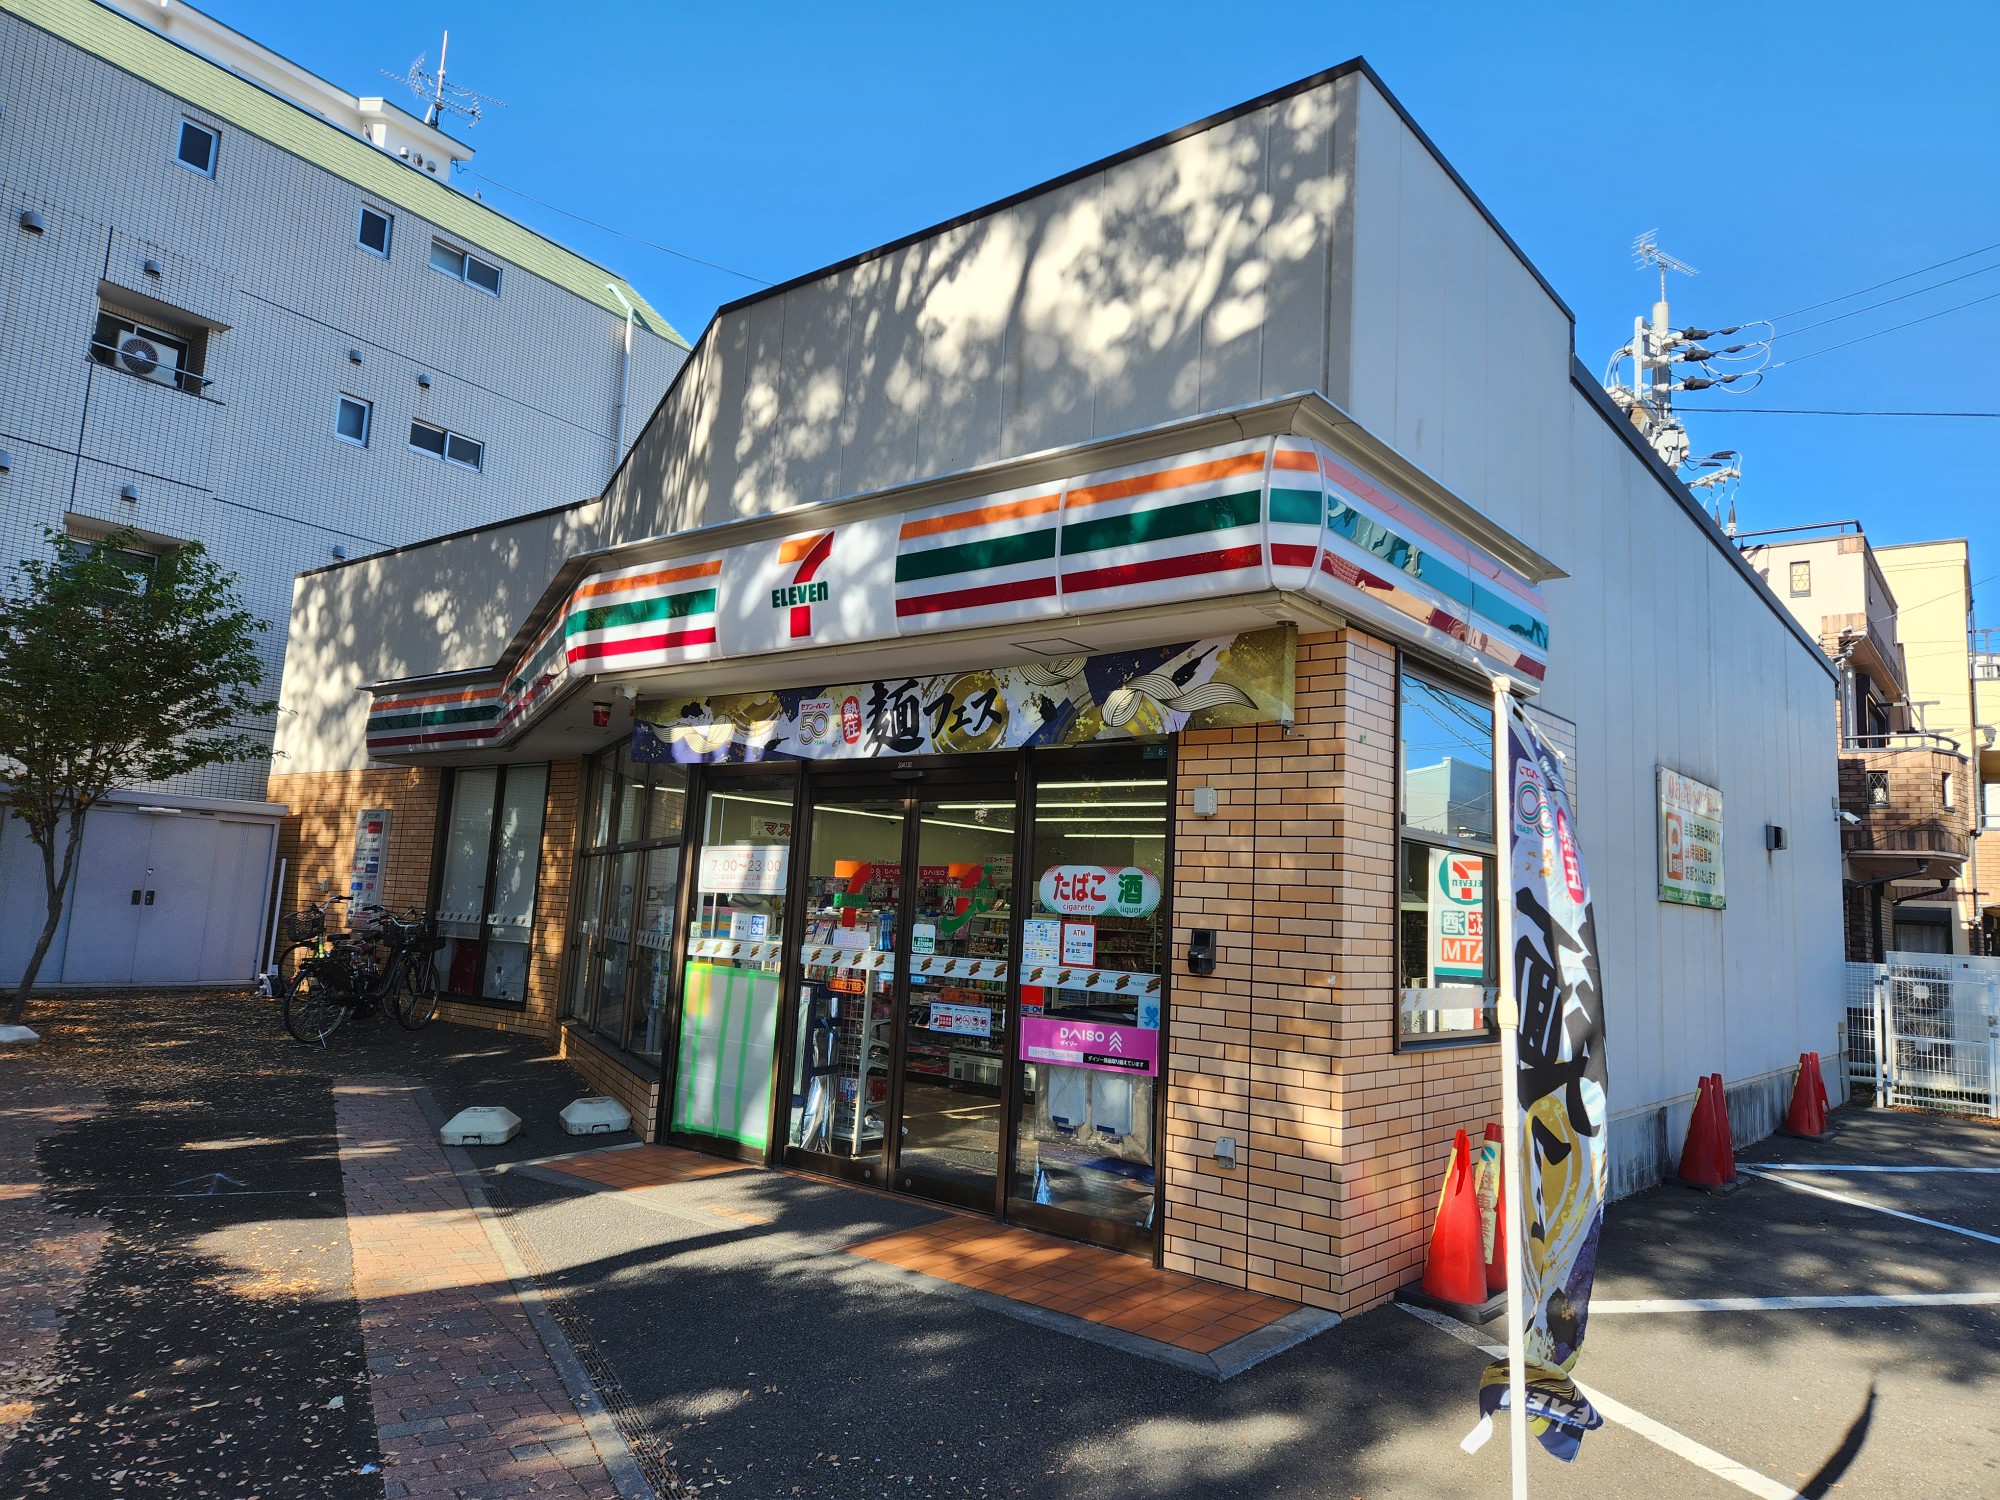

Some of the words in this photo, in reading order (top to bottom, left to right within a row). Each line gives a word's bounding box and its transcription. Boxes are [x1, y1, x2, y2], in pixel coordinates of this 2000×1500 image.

[799, 711, 830, 745] 50
[1053, 872, 1107, 902] たばこ
[1117, 873, 1144, 905] 酒
[1062, 902, 1096, 912] cigarette
[1120, 905, 1143, 914] liquor
[1072, 929, 1087, 937] ATM
[1060, 1027, 1105, 1043] DAISO
